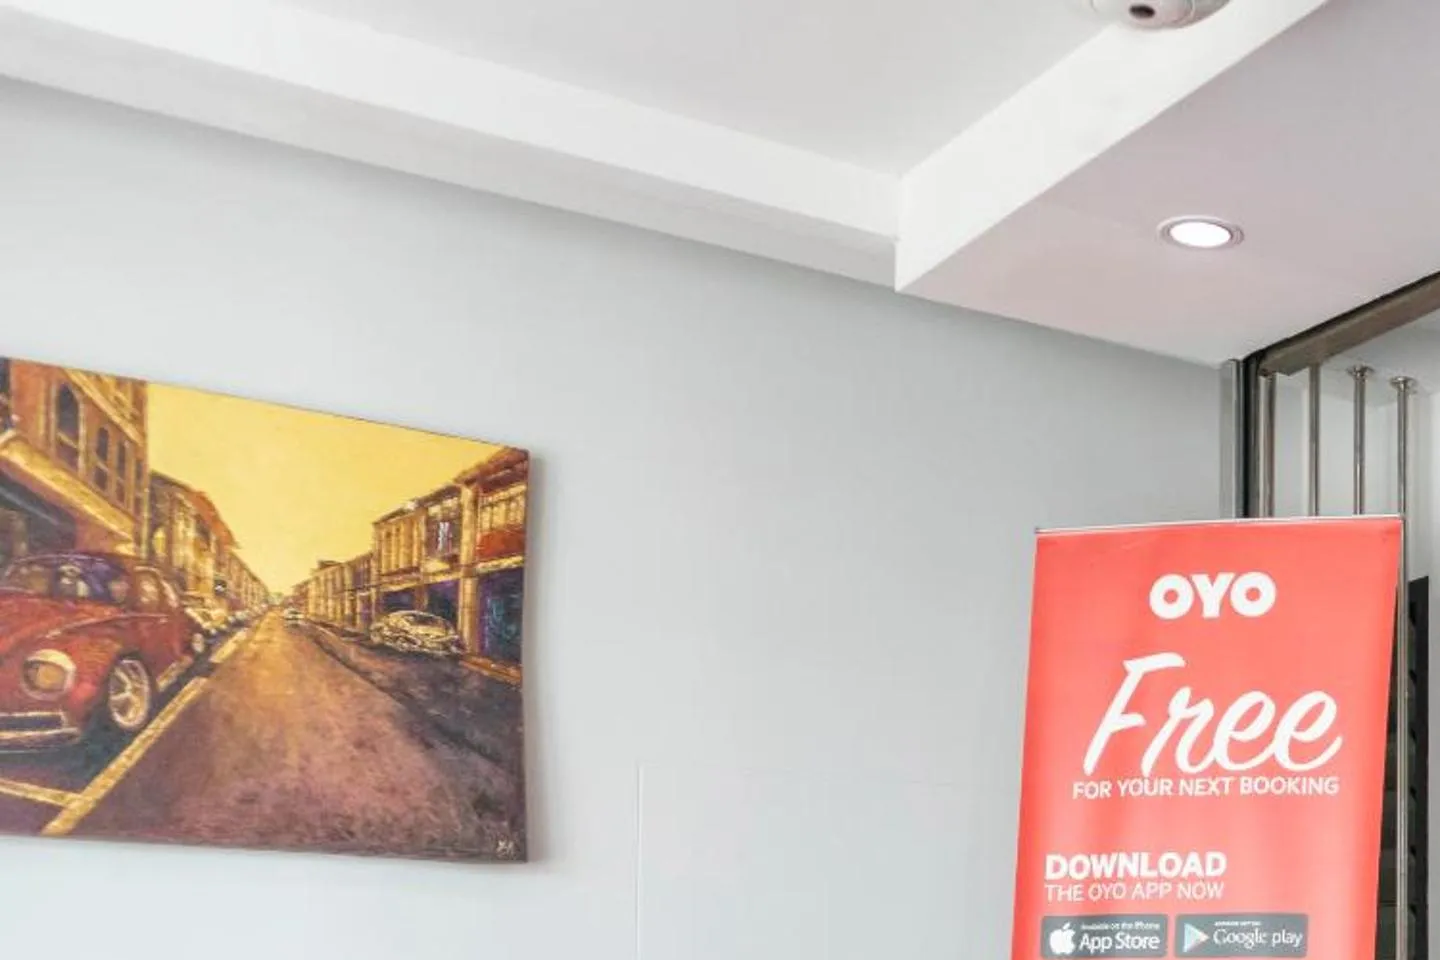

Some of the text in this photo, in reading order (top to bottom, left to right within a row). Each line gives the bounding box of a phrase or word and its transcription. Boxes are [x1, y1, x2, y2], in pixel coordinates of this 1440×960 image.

[1148, 570, 1278, 620] OYO
[1082, 651, 1344, 778] Free
[1072, 775, 1340, 800] FOR YOUR NEXT BOOKING
[1045, 851, 1228, 881] DOWNLOAD
[1044, 880, 1225, 903] THE OYO APP NOW
[1078, 931, 1162, 955] App Store
[1212, 928, 1303, 950] Google play
